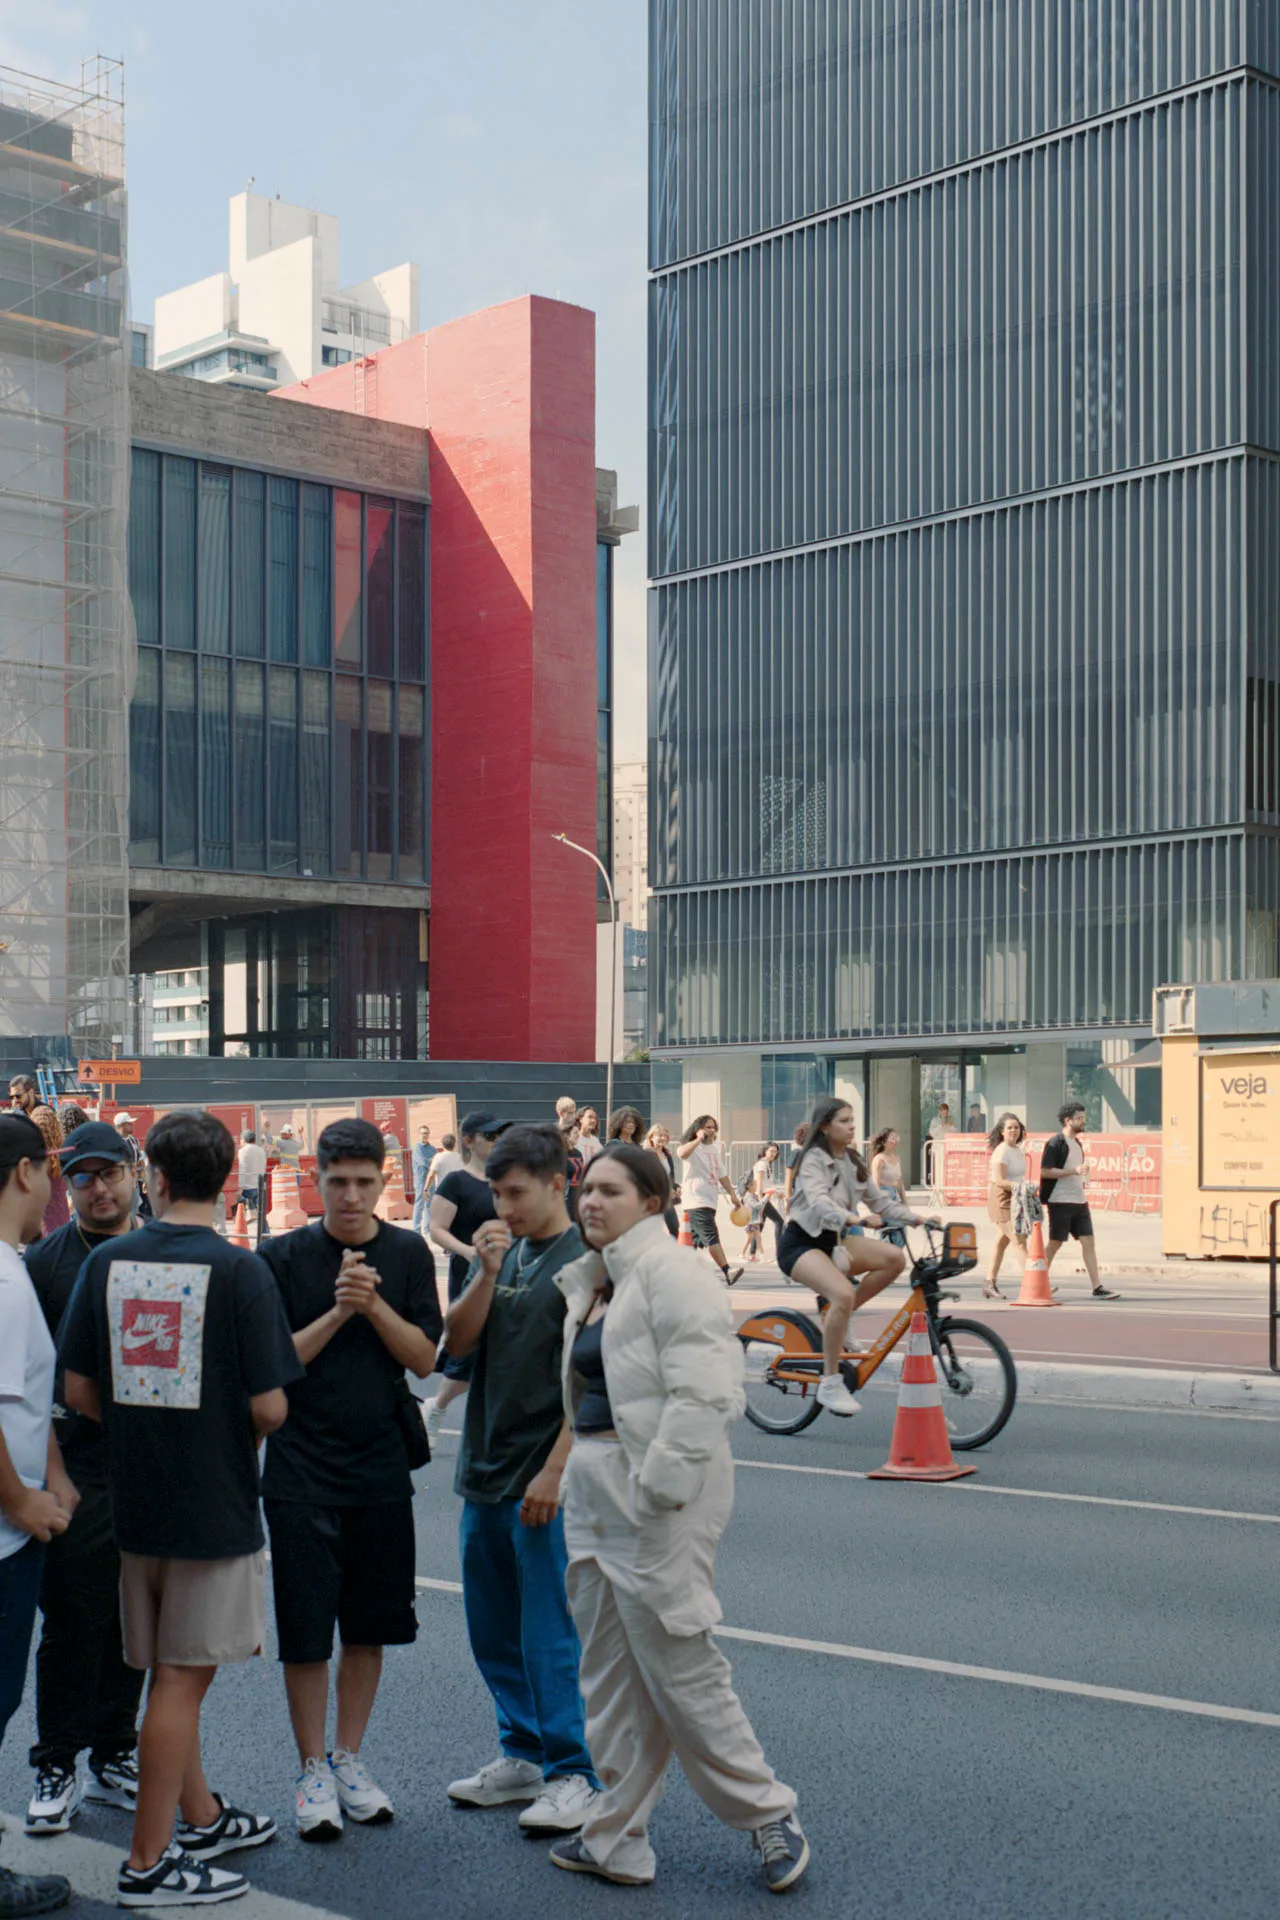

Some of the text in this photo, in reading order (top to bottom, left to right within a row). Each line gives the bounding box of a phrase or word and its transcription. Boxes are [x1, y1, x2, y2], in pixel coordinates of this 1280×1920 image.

[98, 1067, 135, 1076] DESVIO
[1220, 1073, 1267, 1099] veja
[132, 1313, 170, 1331] NIKE
[155, 1336, 174, 1351] SB
